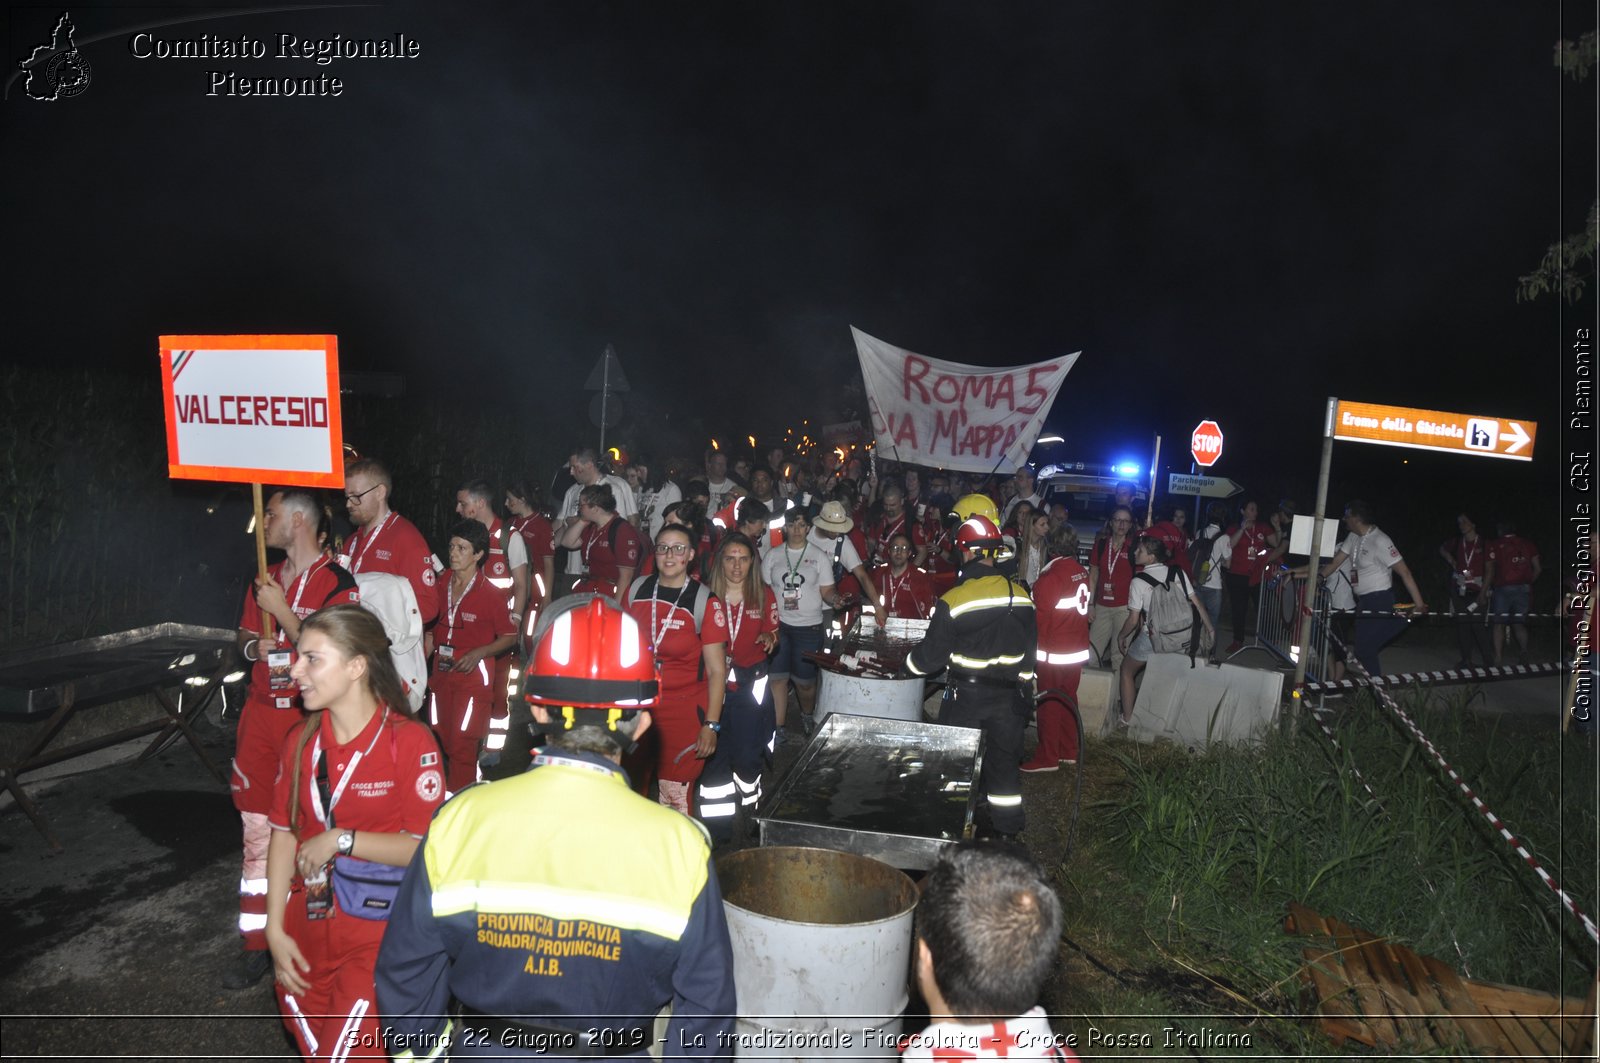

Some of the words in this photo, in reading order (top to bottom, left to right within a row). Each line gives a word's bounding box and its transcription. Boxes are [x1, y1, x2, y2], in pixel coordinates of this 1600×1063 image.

[903, 354, 1015, 411] ROMA
[1016, 363, 1060, 415] 5
[175, 394, 328, 428] VALCERESIO
[1342, 411, 1379, 429] Eremo
[1381, 417, 1413, 433] della
[1416, 420, 1464, 438] Ghisiola
[1193, 434, 1221, 453] STOP
[1171, 483, 1201, 494] Parking
[1172, 475, 1215, 487] Parcheggio
[350, 782, 373, 790] CROCE
[477, 913, 554, 937] PROVINCIA
[557, 921, 574, 938] DI
[577, 921, 621, 943] PAVIA
[477, 930, 536, 951] SQUADRA
[536, 938, 621, 961] PROVINCIALE
[524, 955, 563, 976] A.I.B.
